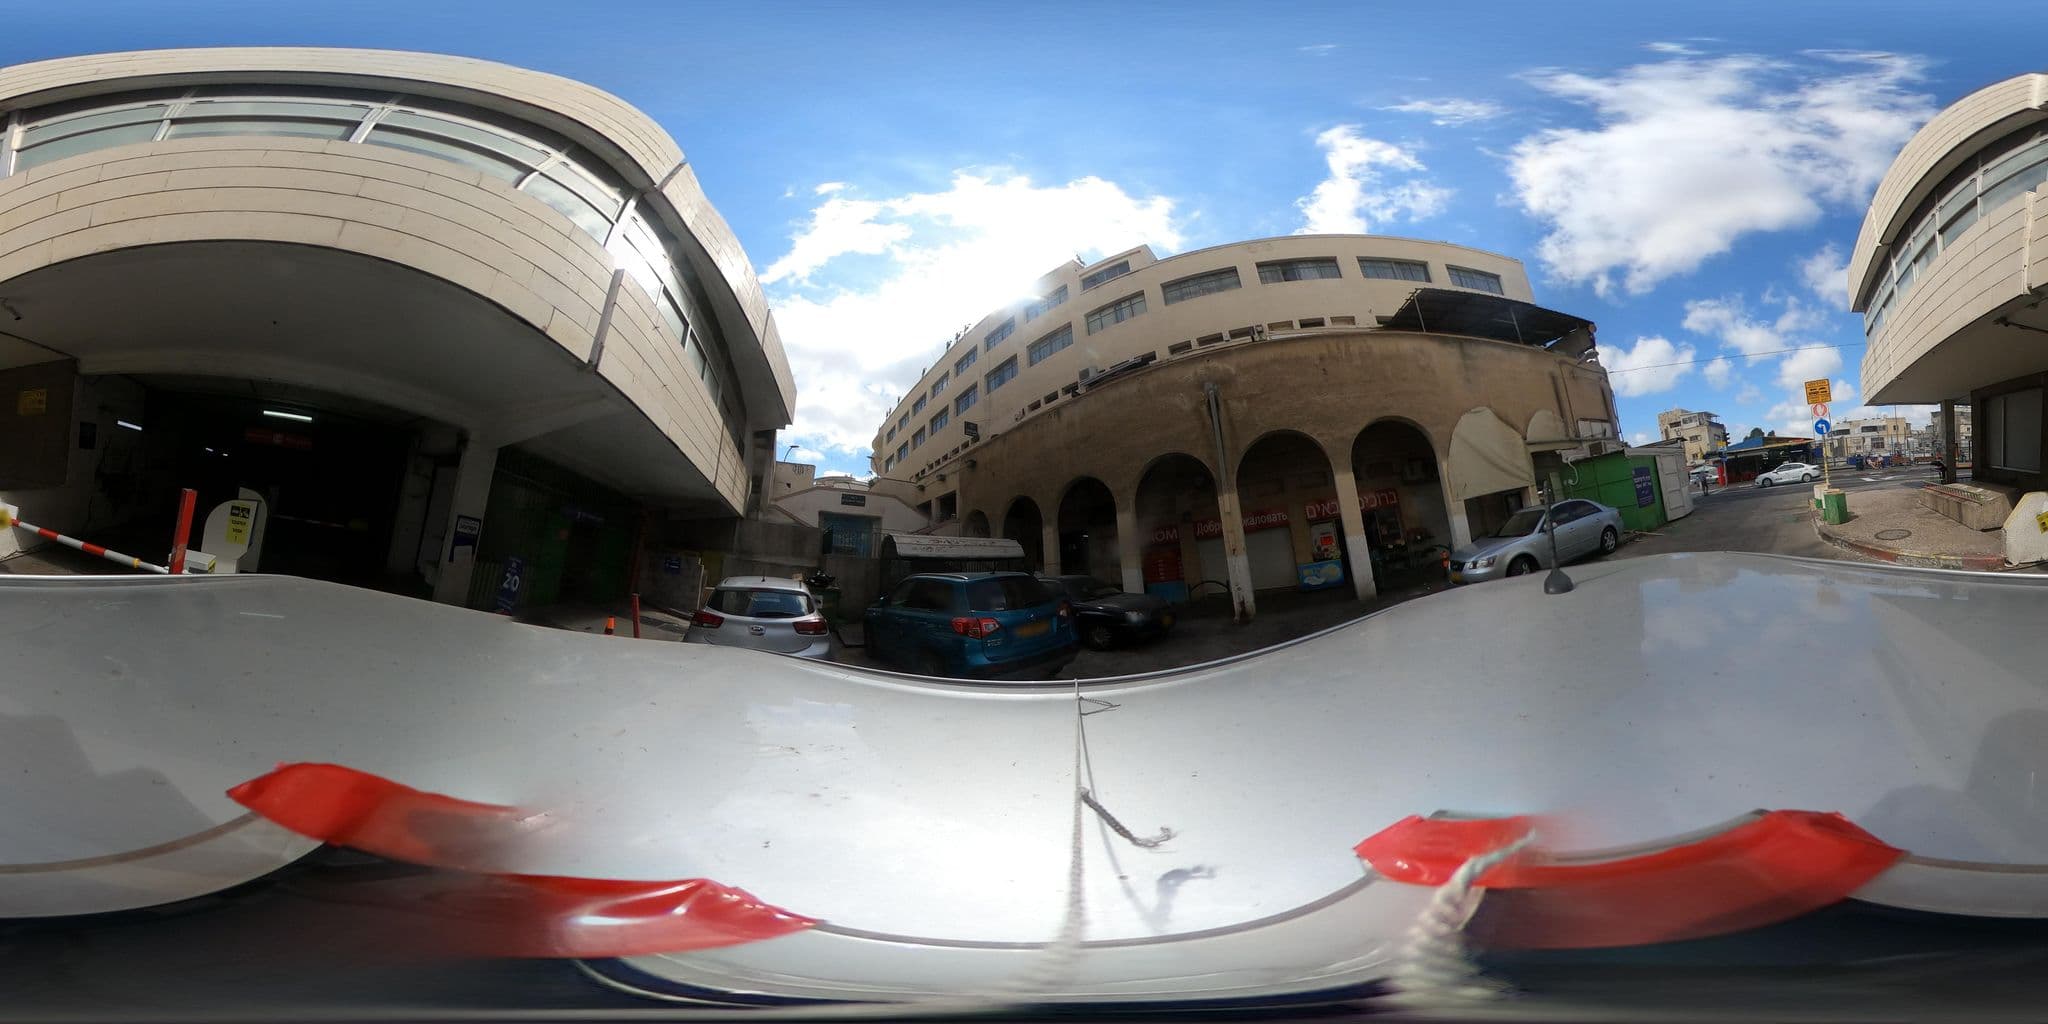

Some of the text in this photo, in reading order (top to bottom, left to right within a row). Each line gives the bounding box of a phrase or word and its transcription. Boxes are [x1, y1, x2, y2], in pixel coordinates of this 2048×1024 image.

[1306, 501, 1339, 519] באים
[1197, 512, 1288, 536] Добр жаловать
[503, 572, 520, 592] 20
